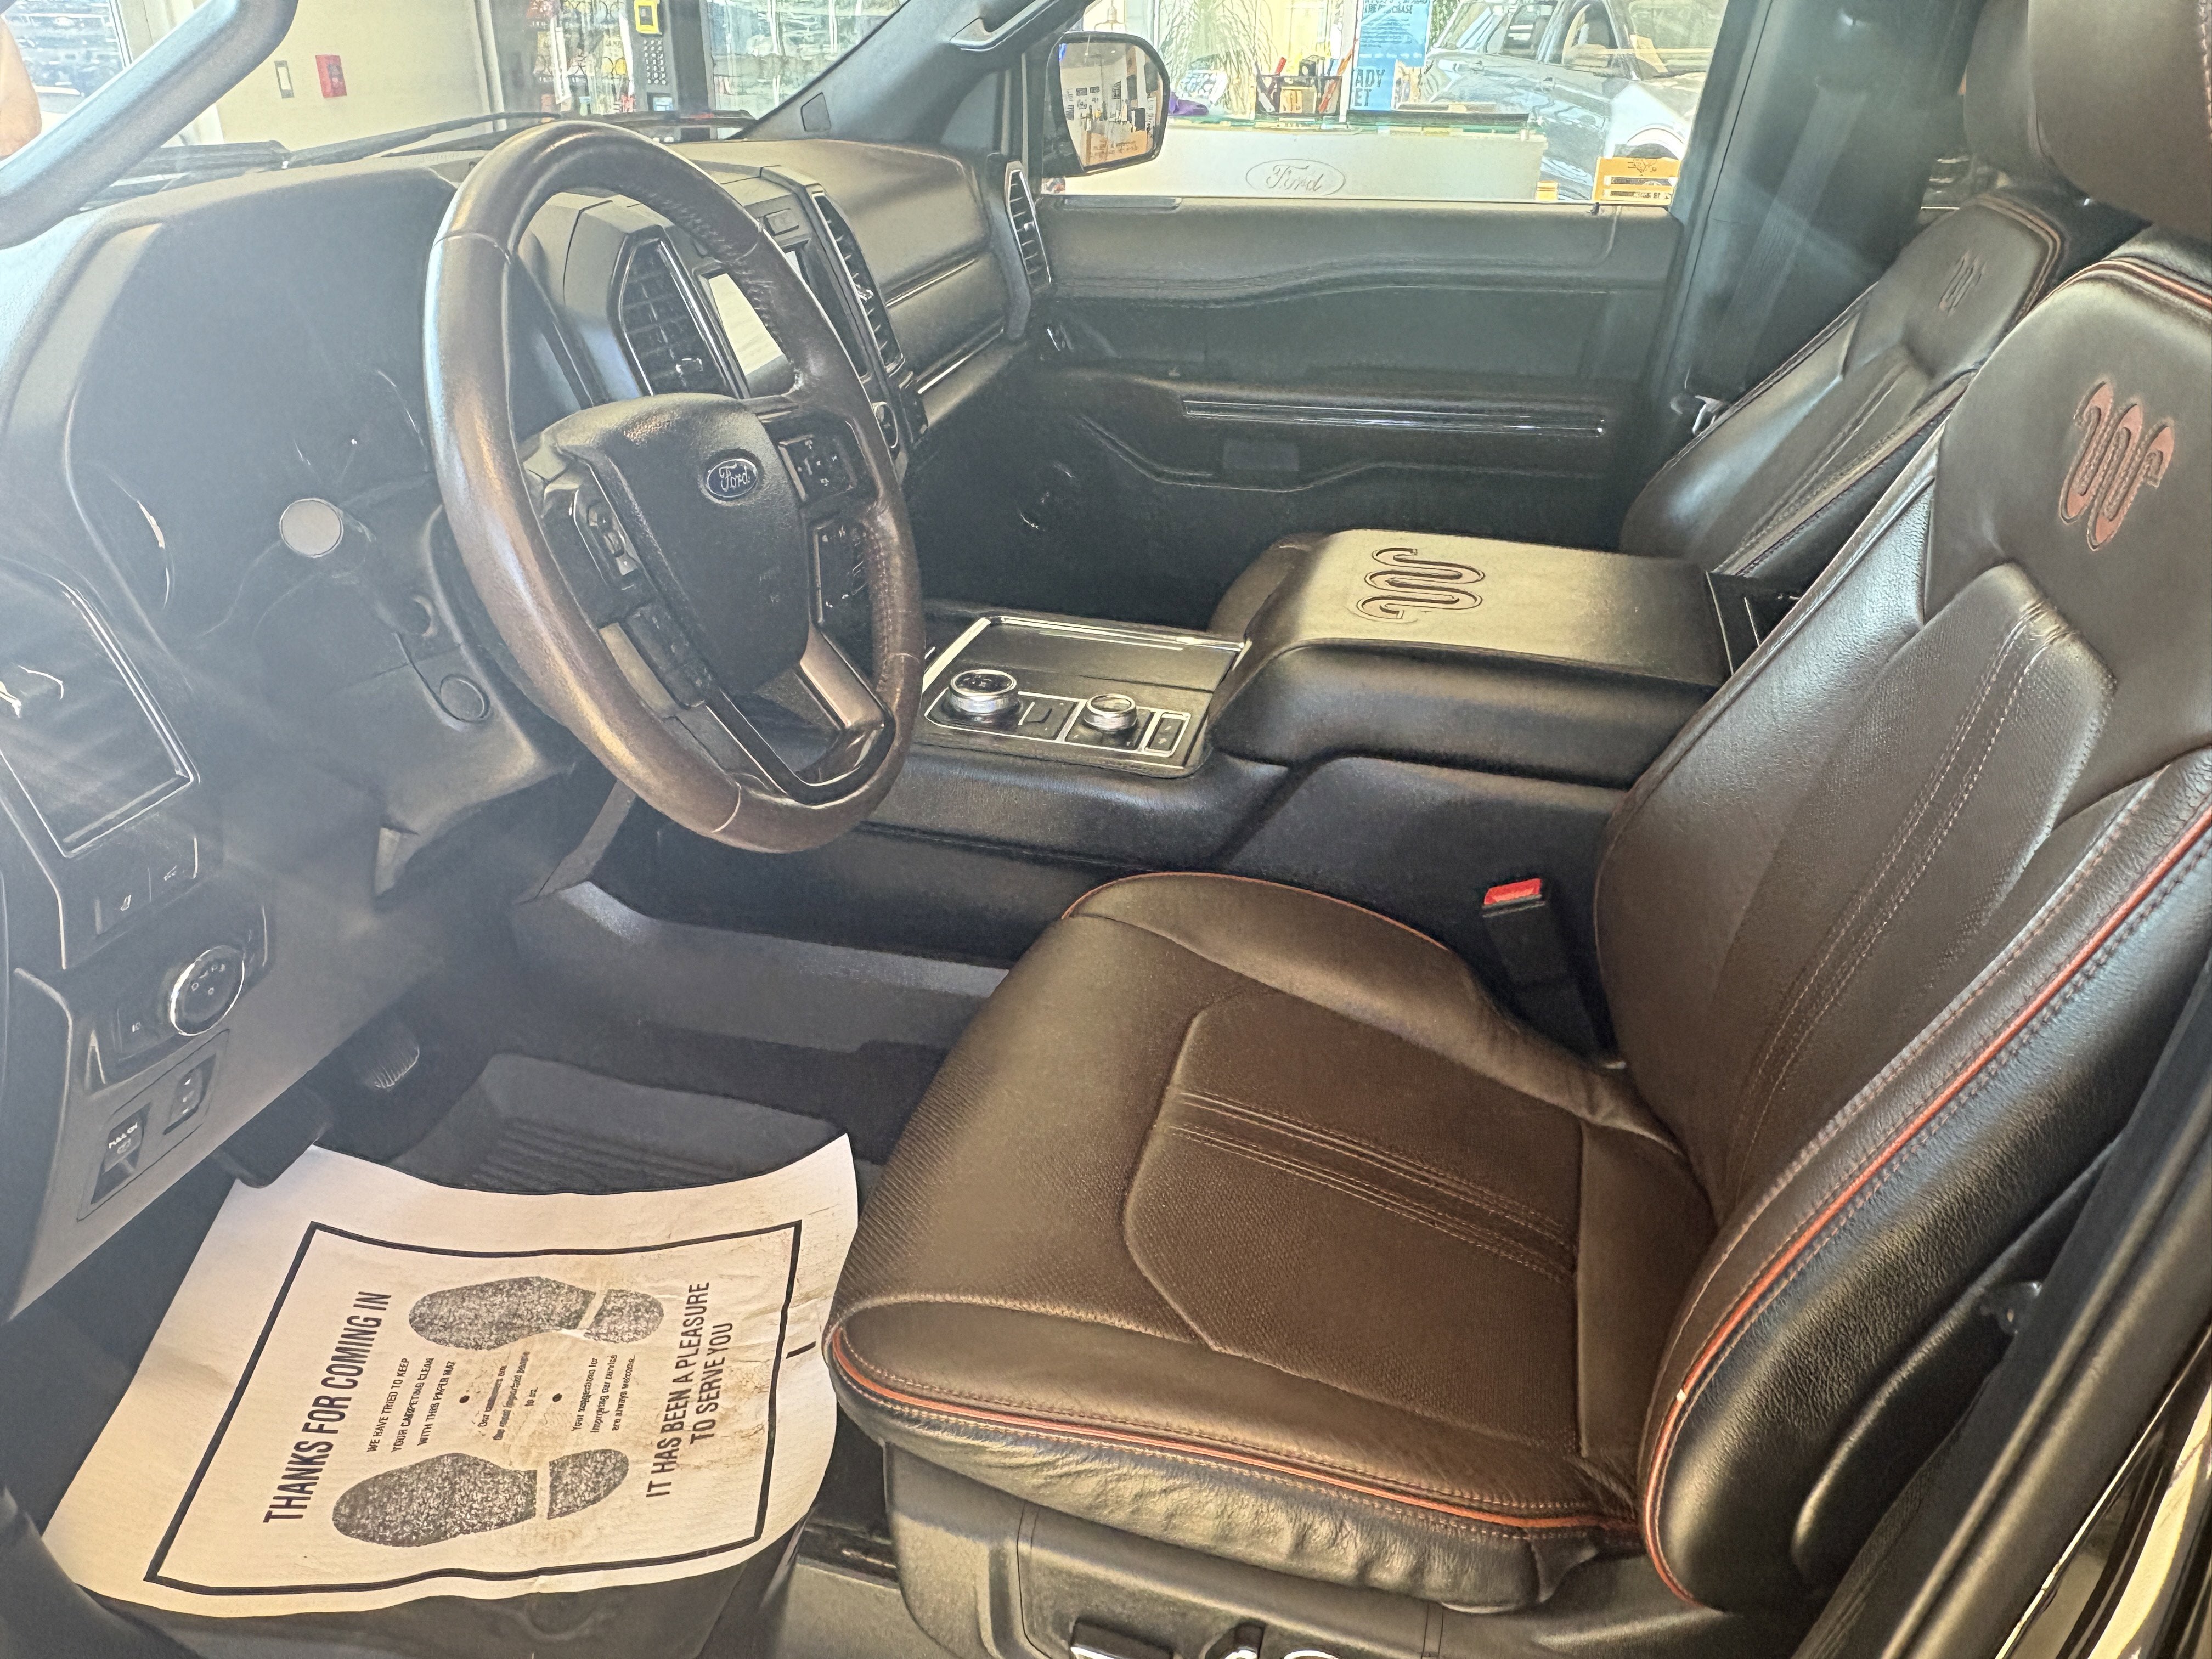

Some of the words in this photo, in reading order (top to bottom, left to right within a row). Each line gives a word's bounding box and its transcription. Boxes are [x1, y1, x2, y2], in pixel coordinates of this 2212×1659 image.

[1356, 69, 1386, 88] ADY
[1354, 88, 1372, 106] ET
[1266, 164, 1324, 191] Ford
[719, 463, 751, 492] Ford
[353, 1291, 392, 1311] IN
[675, 1282, 709, 1369] PLEASURE
[706, 1322, 733, 1356] YOU
[321, 1315, 382, 1390] COMING
[397, 1358, 409, 1377] KEEP
[672, 1371, 694, 1384] A
[391, 1379, 403, 1389] TO
[696, 1357, 725, 1417] SERVE
[302, 1395, 352, 1434] FOR
[381, 1391, 398, 1414] TRIED
[661, 1388, 692, 1434] BEEN
[373, 1417, 389, 1437] HAVE
[417, 1424, 433, 1446] WITH
[690, 1419, 716, 1445] TO
[367, 1438, 380, 1452] WE
[391, 1429, 408, 1453] YOUR
[651, 1437, 682, 1474] HAS
[263, 1441, 334, 1523] THANKS
[646, 1480, 672, 1498] IT
